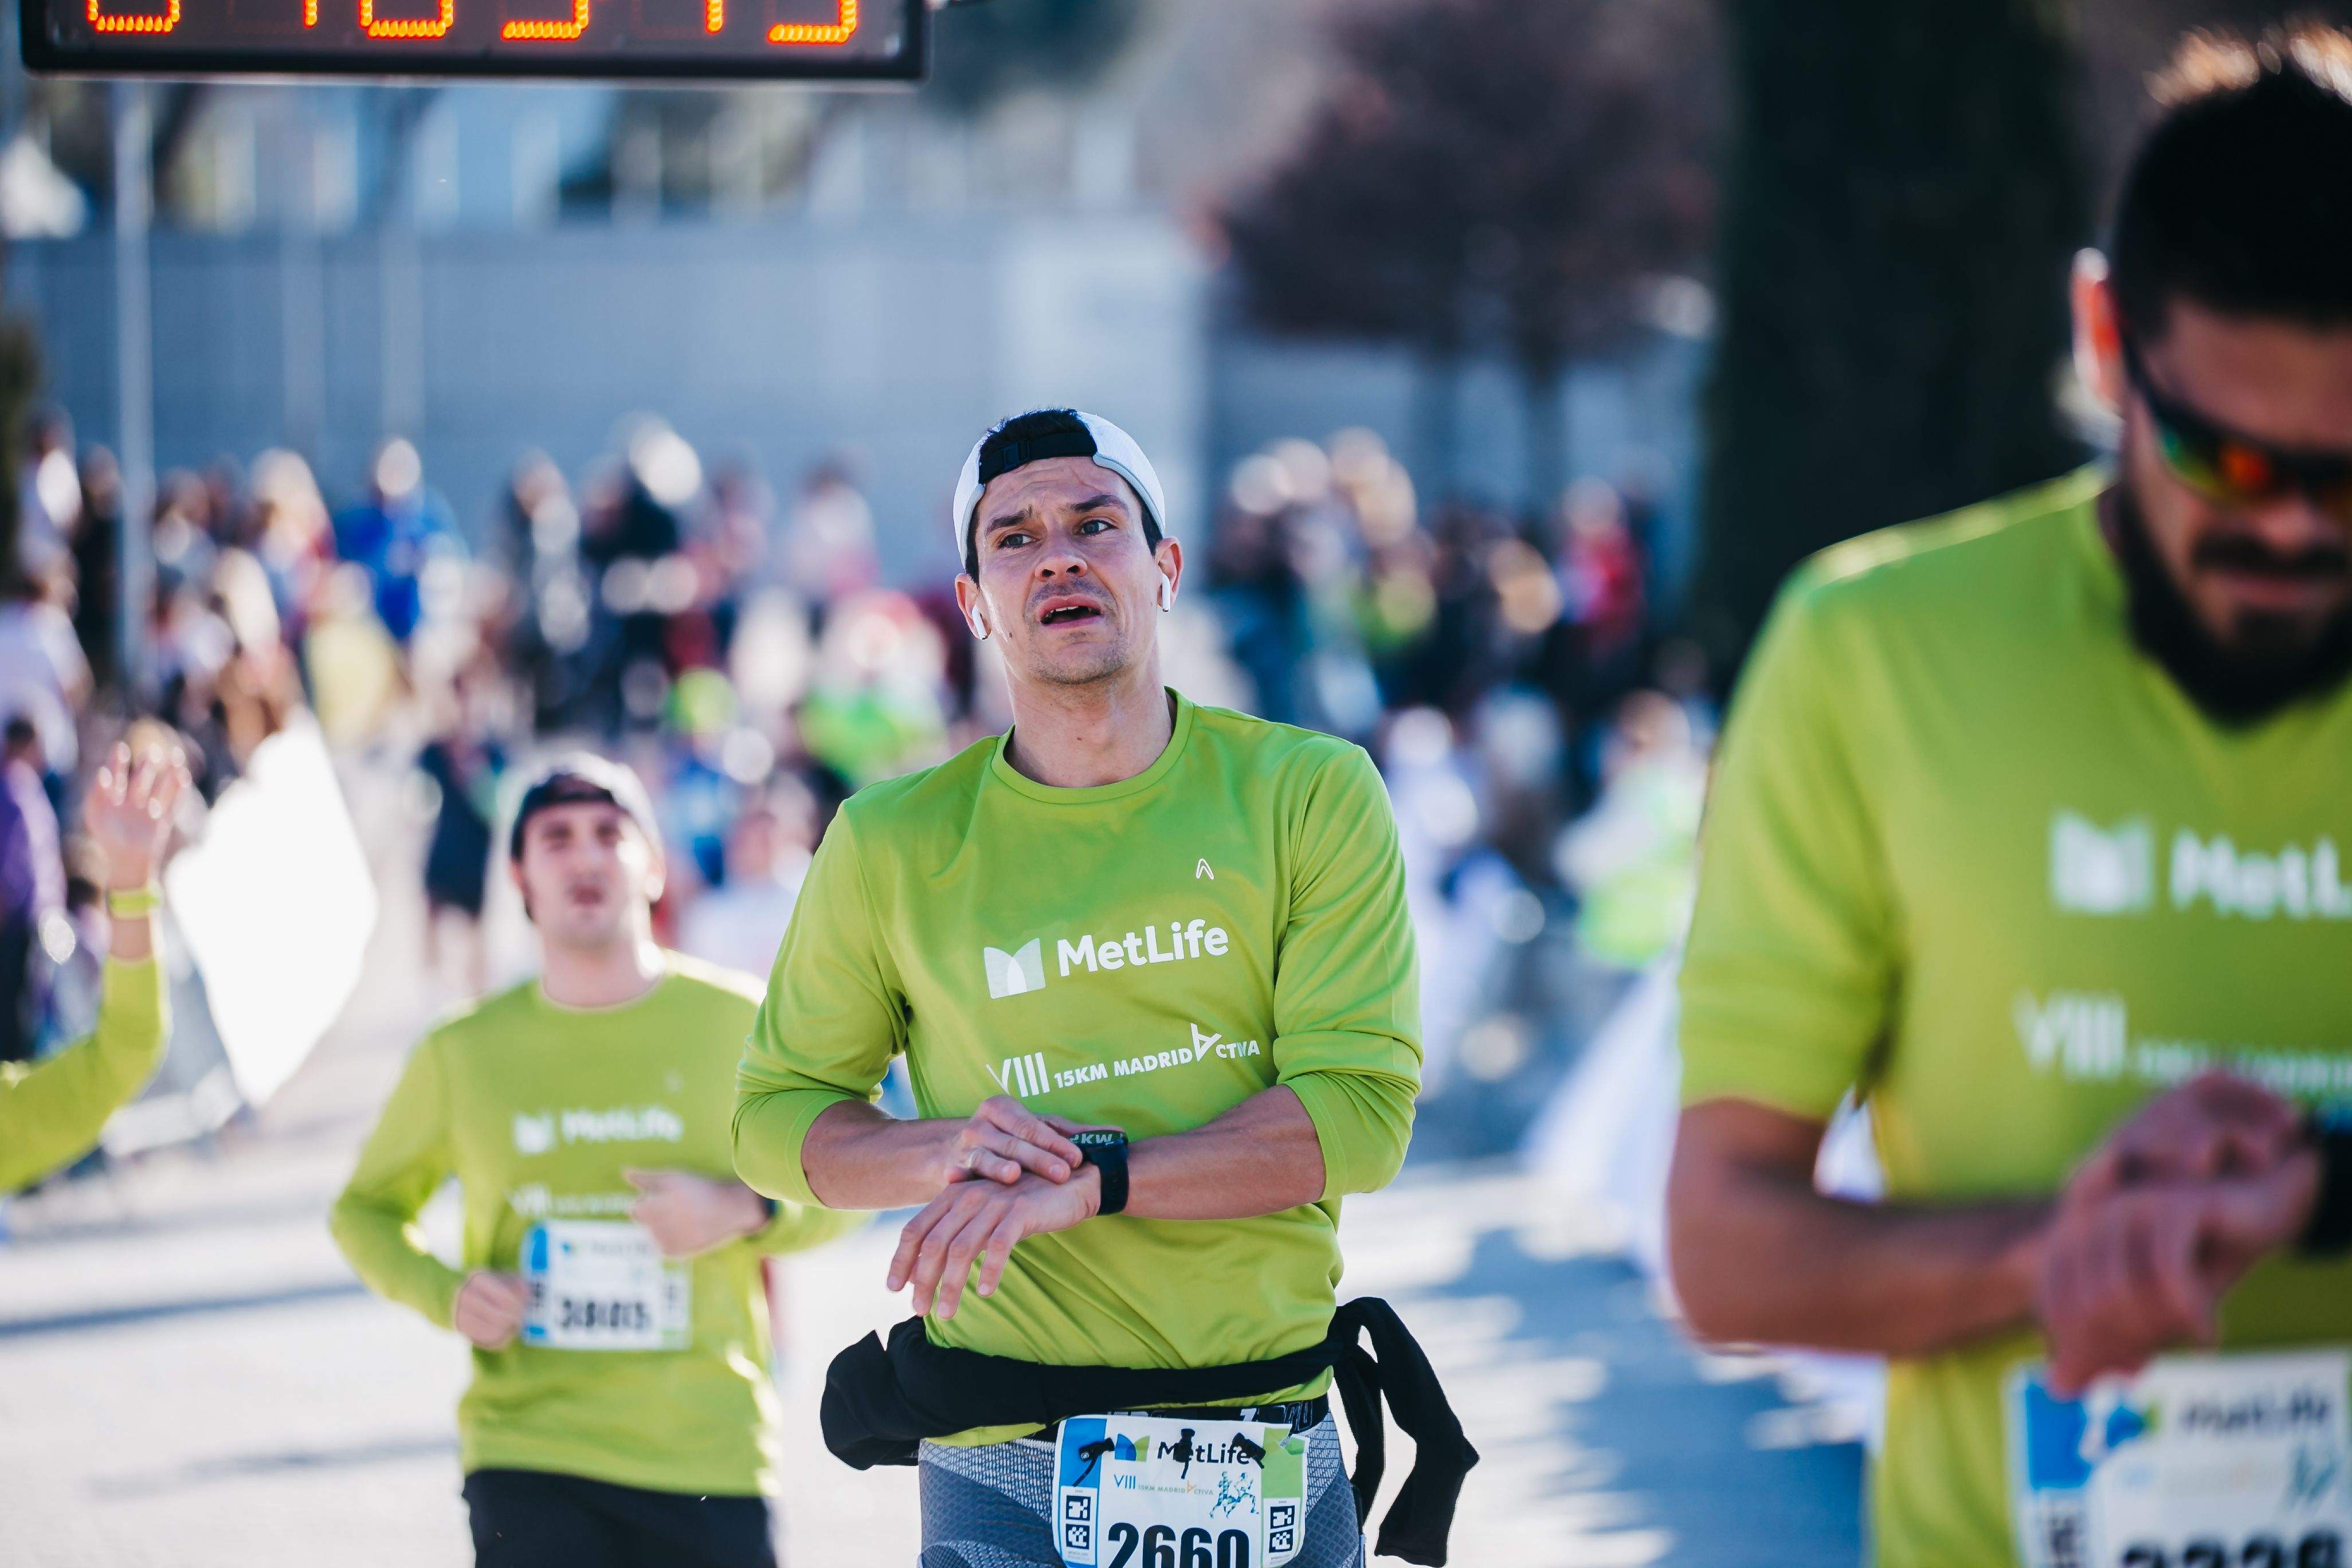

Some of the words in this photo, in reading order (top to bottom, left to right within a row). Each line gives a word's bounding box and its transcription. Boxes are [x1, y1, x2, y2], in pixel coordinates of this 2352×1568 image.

[1057, 919, 1229, 977] MetLife
[986, 1052, 1050, 1097] VIII
[1054, 1063, 1108, 1088] 15KM
[1114, 1047, 1193, 1076] MADRID
[1114, 1475, 1136, 1489] VIII
[1108, 1522, 1249, 1568] 2660
